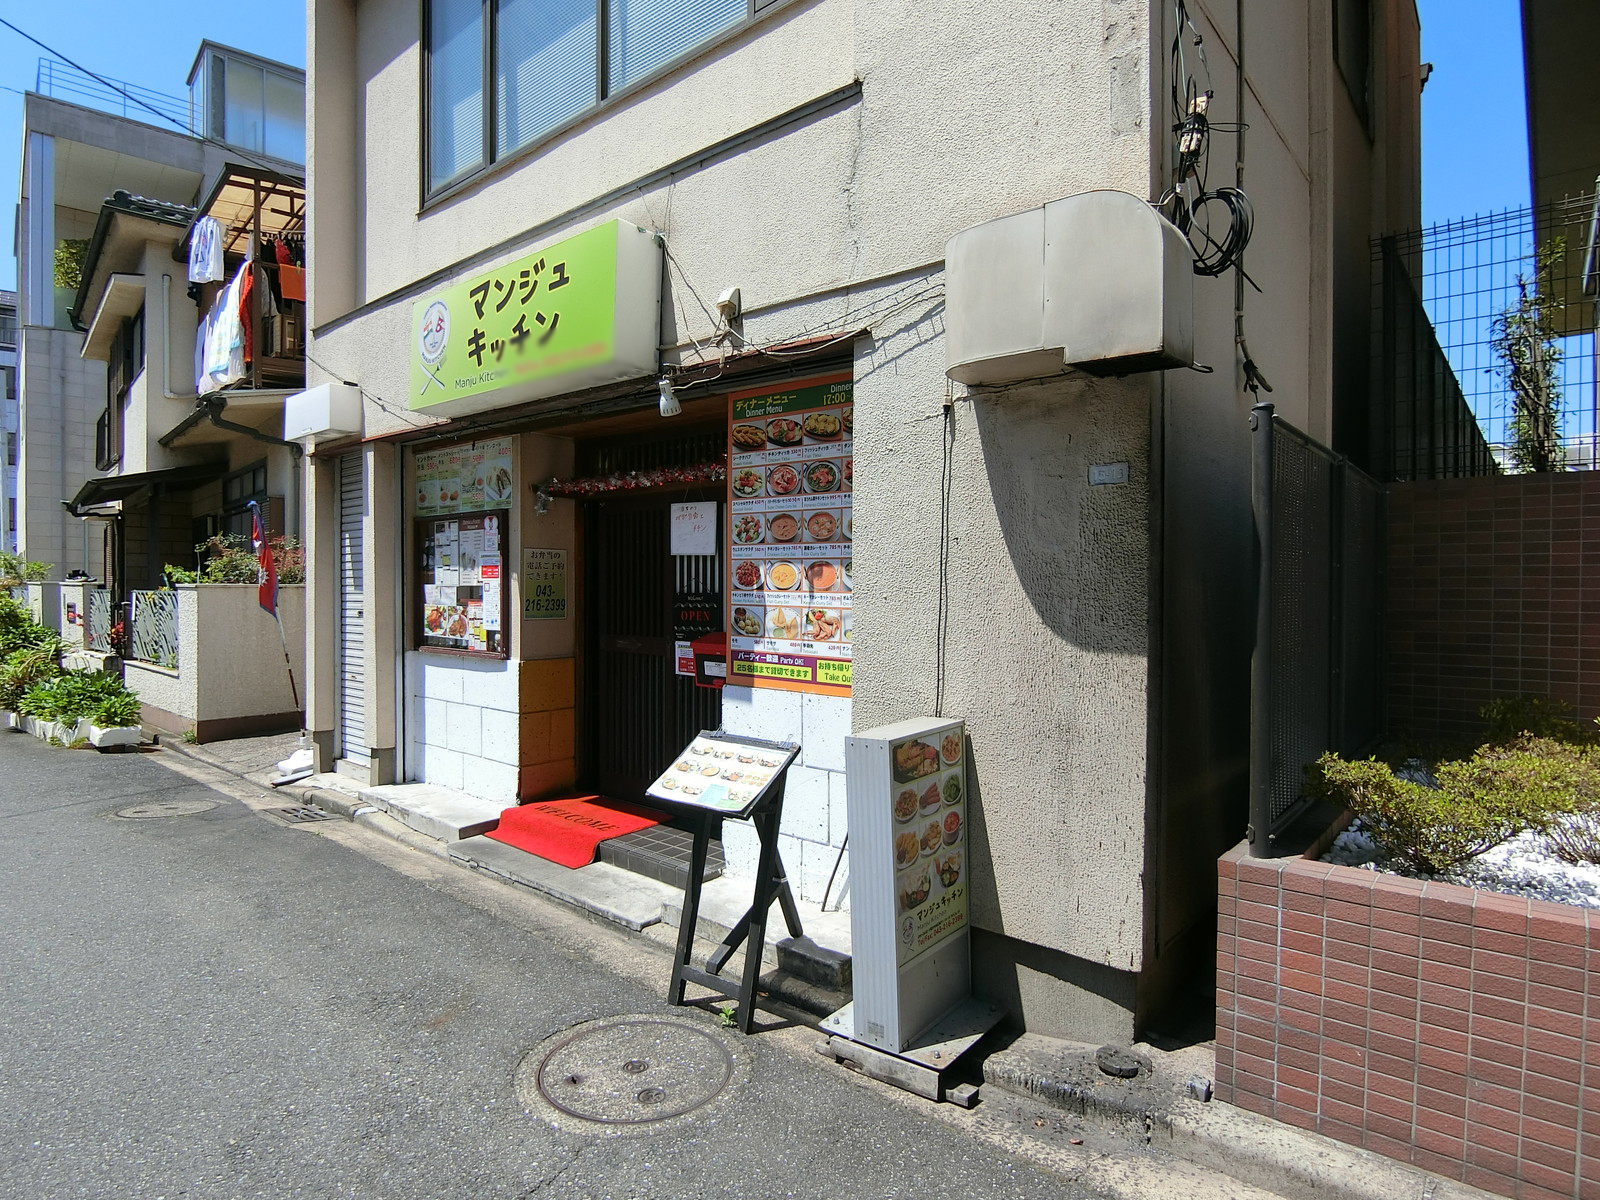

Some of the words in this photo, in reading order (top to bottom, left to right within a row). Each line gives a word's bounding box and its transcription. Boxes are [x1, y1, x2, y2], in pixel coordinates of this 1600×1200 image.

[469, 257, 570, 320] マンジュ
[467, 312, 560, 367] キッチン
[455, 376, 476, 389] Manju
[736, 394, 796, 411] ディナーメニュー
[746, 408, 765, 417] Dinner
[766, 406, 782, 414] Menu
[530, 551, 560, 560] お弁当の
[526, 561, 564, 570] 電話ご予約
[536, 584, 555, 597] 043-
[525, 598, 566, 611] 216-2399
[681, 610, 710, 620] OPEN
[818, 662, 852, 672] お持ち帰り
[825, 673, 840, 682] Take
[534, 804, 620, 831] WELCOME
[917, 889, 963, 921] マンジュキッチン
